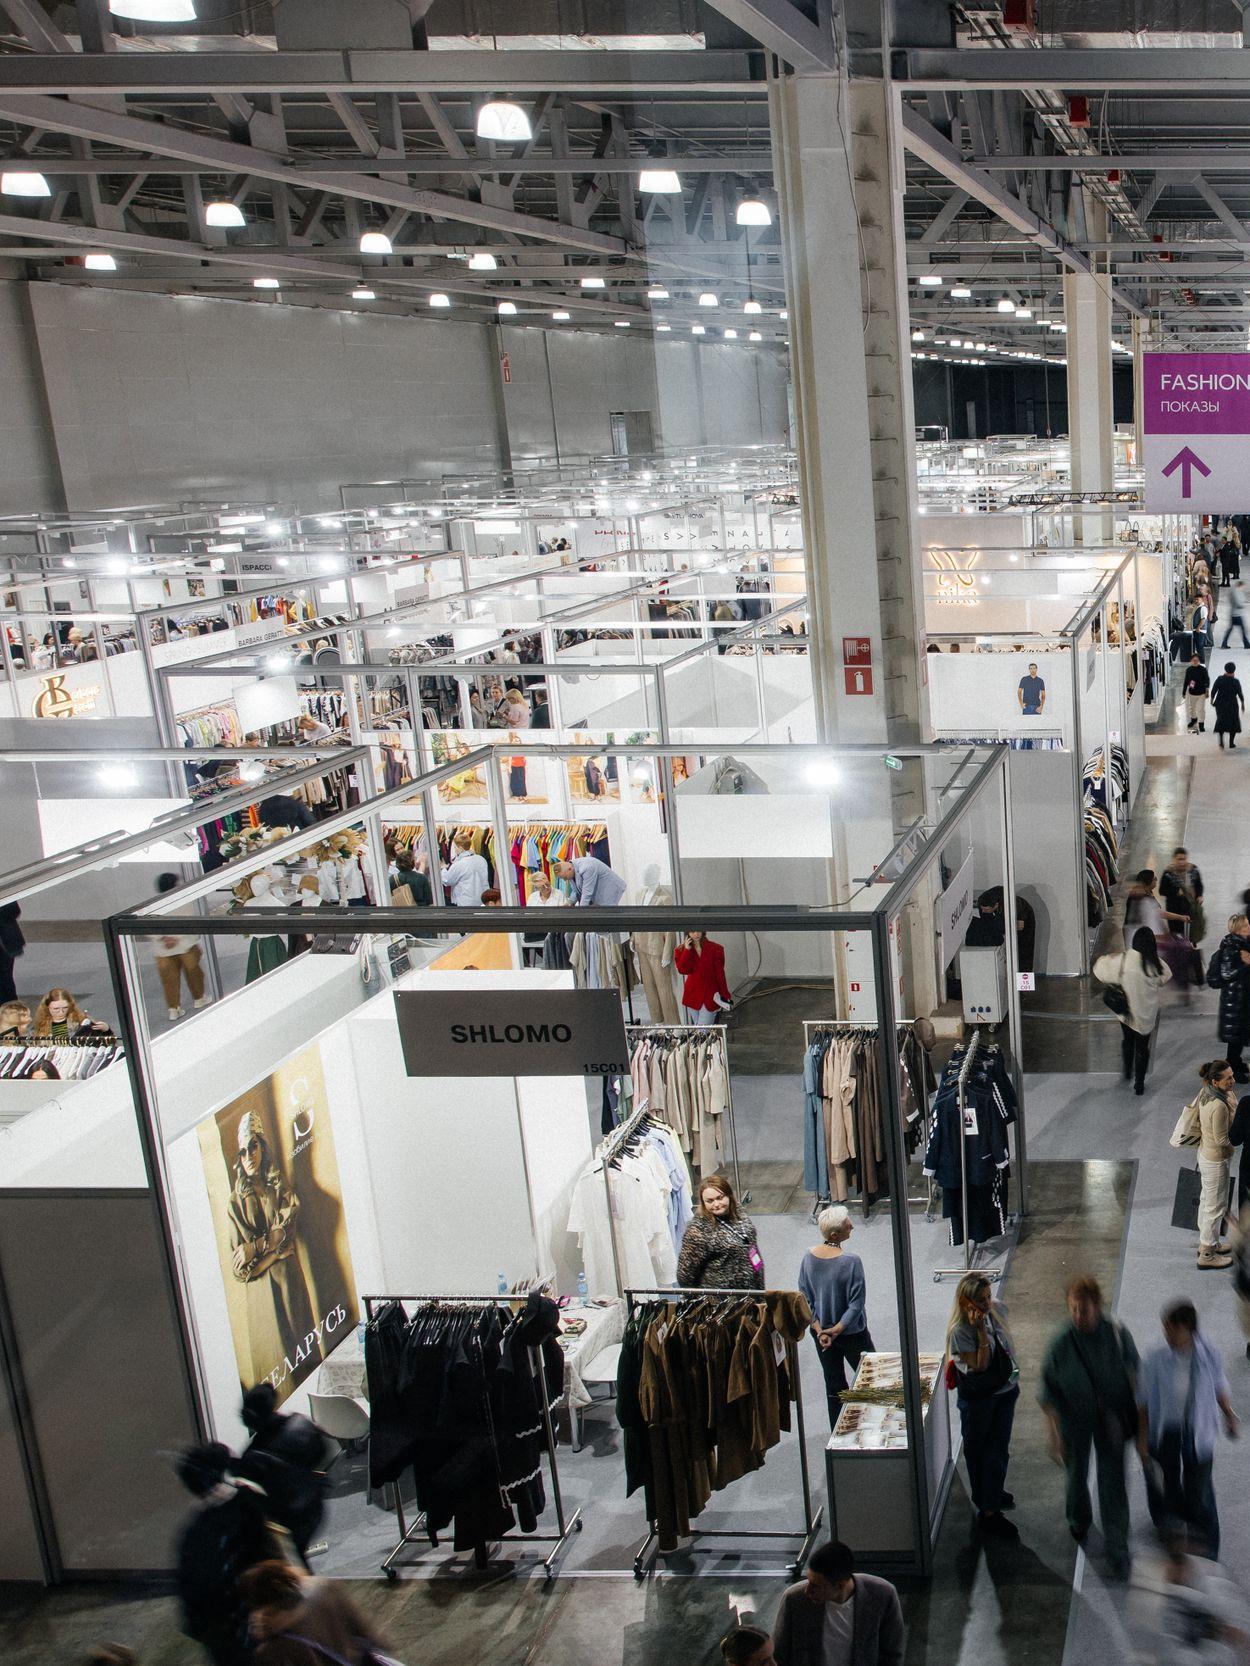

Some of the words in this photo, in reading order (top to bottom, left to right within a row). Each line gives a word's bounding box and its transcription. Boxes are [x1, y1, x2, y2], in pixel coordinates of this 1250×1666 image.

[1160, 374, 1250, 391] FASHION
[1160, 401, 1220, 413] ПОКАЗЫ
[450, 1023, 573, 1044] SHLOMO
[582, 1062, 626, 1074] 15C01
